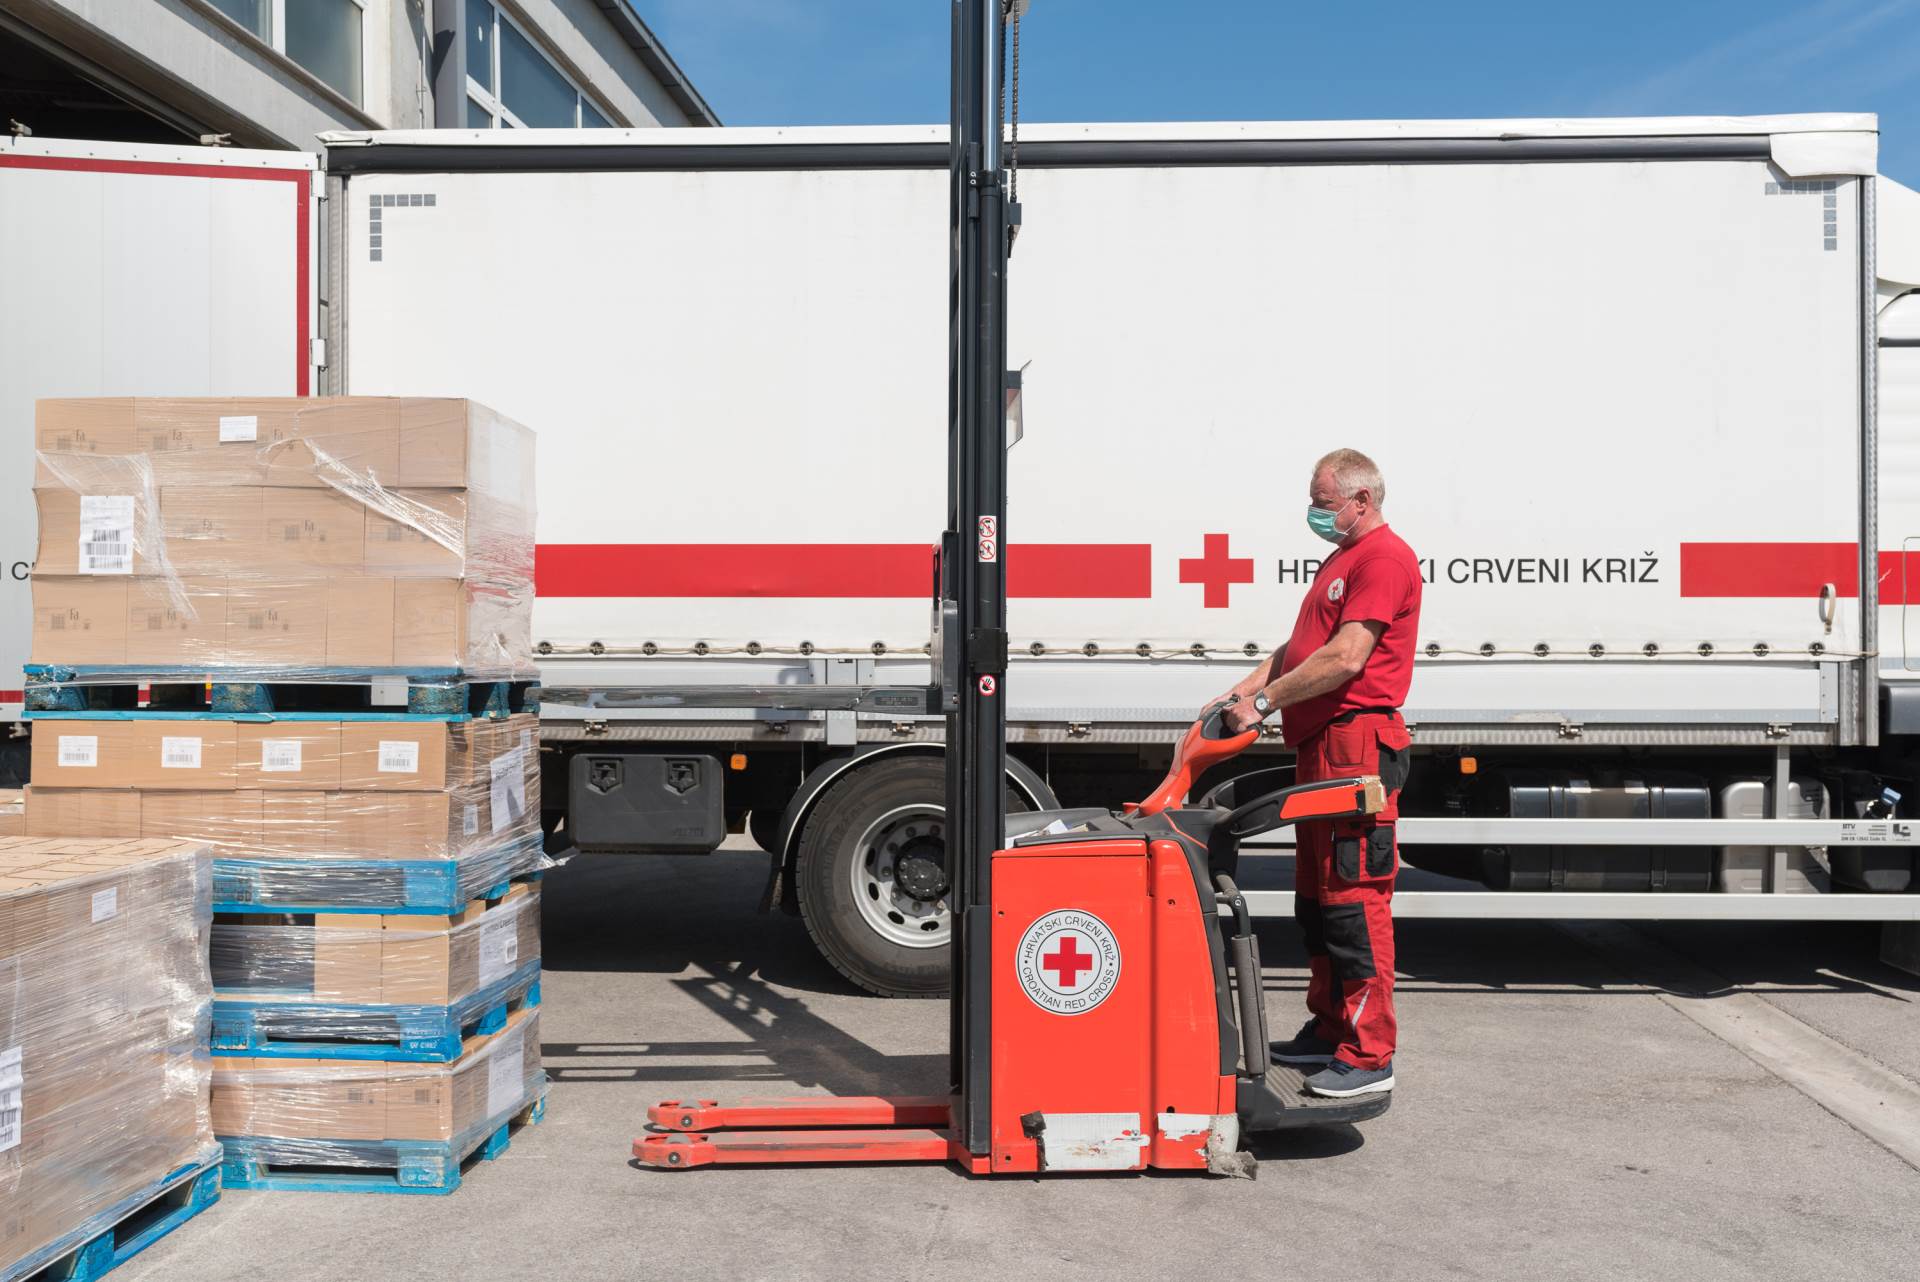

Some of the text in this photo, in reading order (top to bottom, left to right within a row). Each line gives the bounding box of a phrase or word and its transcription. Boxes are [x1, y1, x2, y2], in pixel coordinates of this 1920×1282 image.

[1447, 558, 1569, 583] CRVENI
[1582, 551, 1659, 583] KRIŽ
[1024, 915, 1117, 961] HRVATSKI CRVENI KRIŽ
[1022, 966, 1115, 1009] CROATIAN RED CROSS
